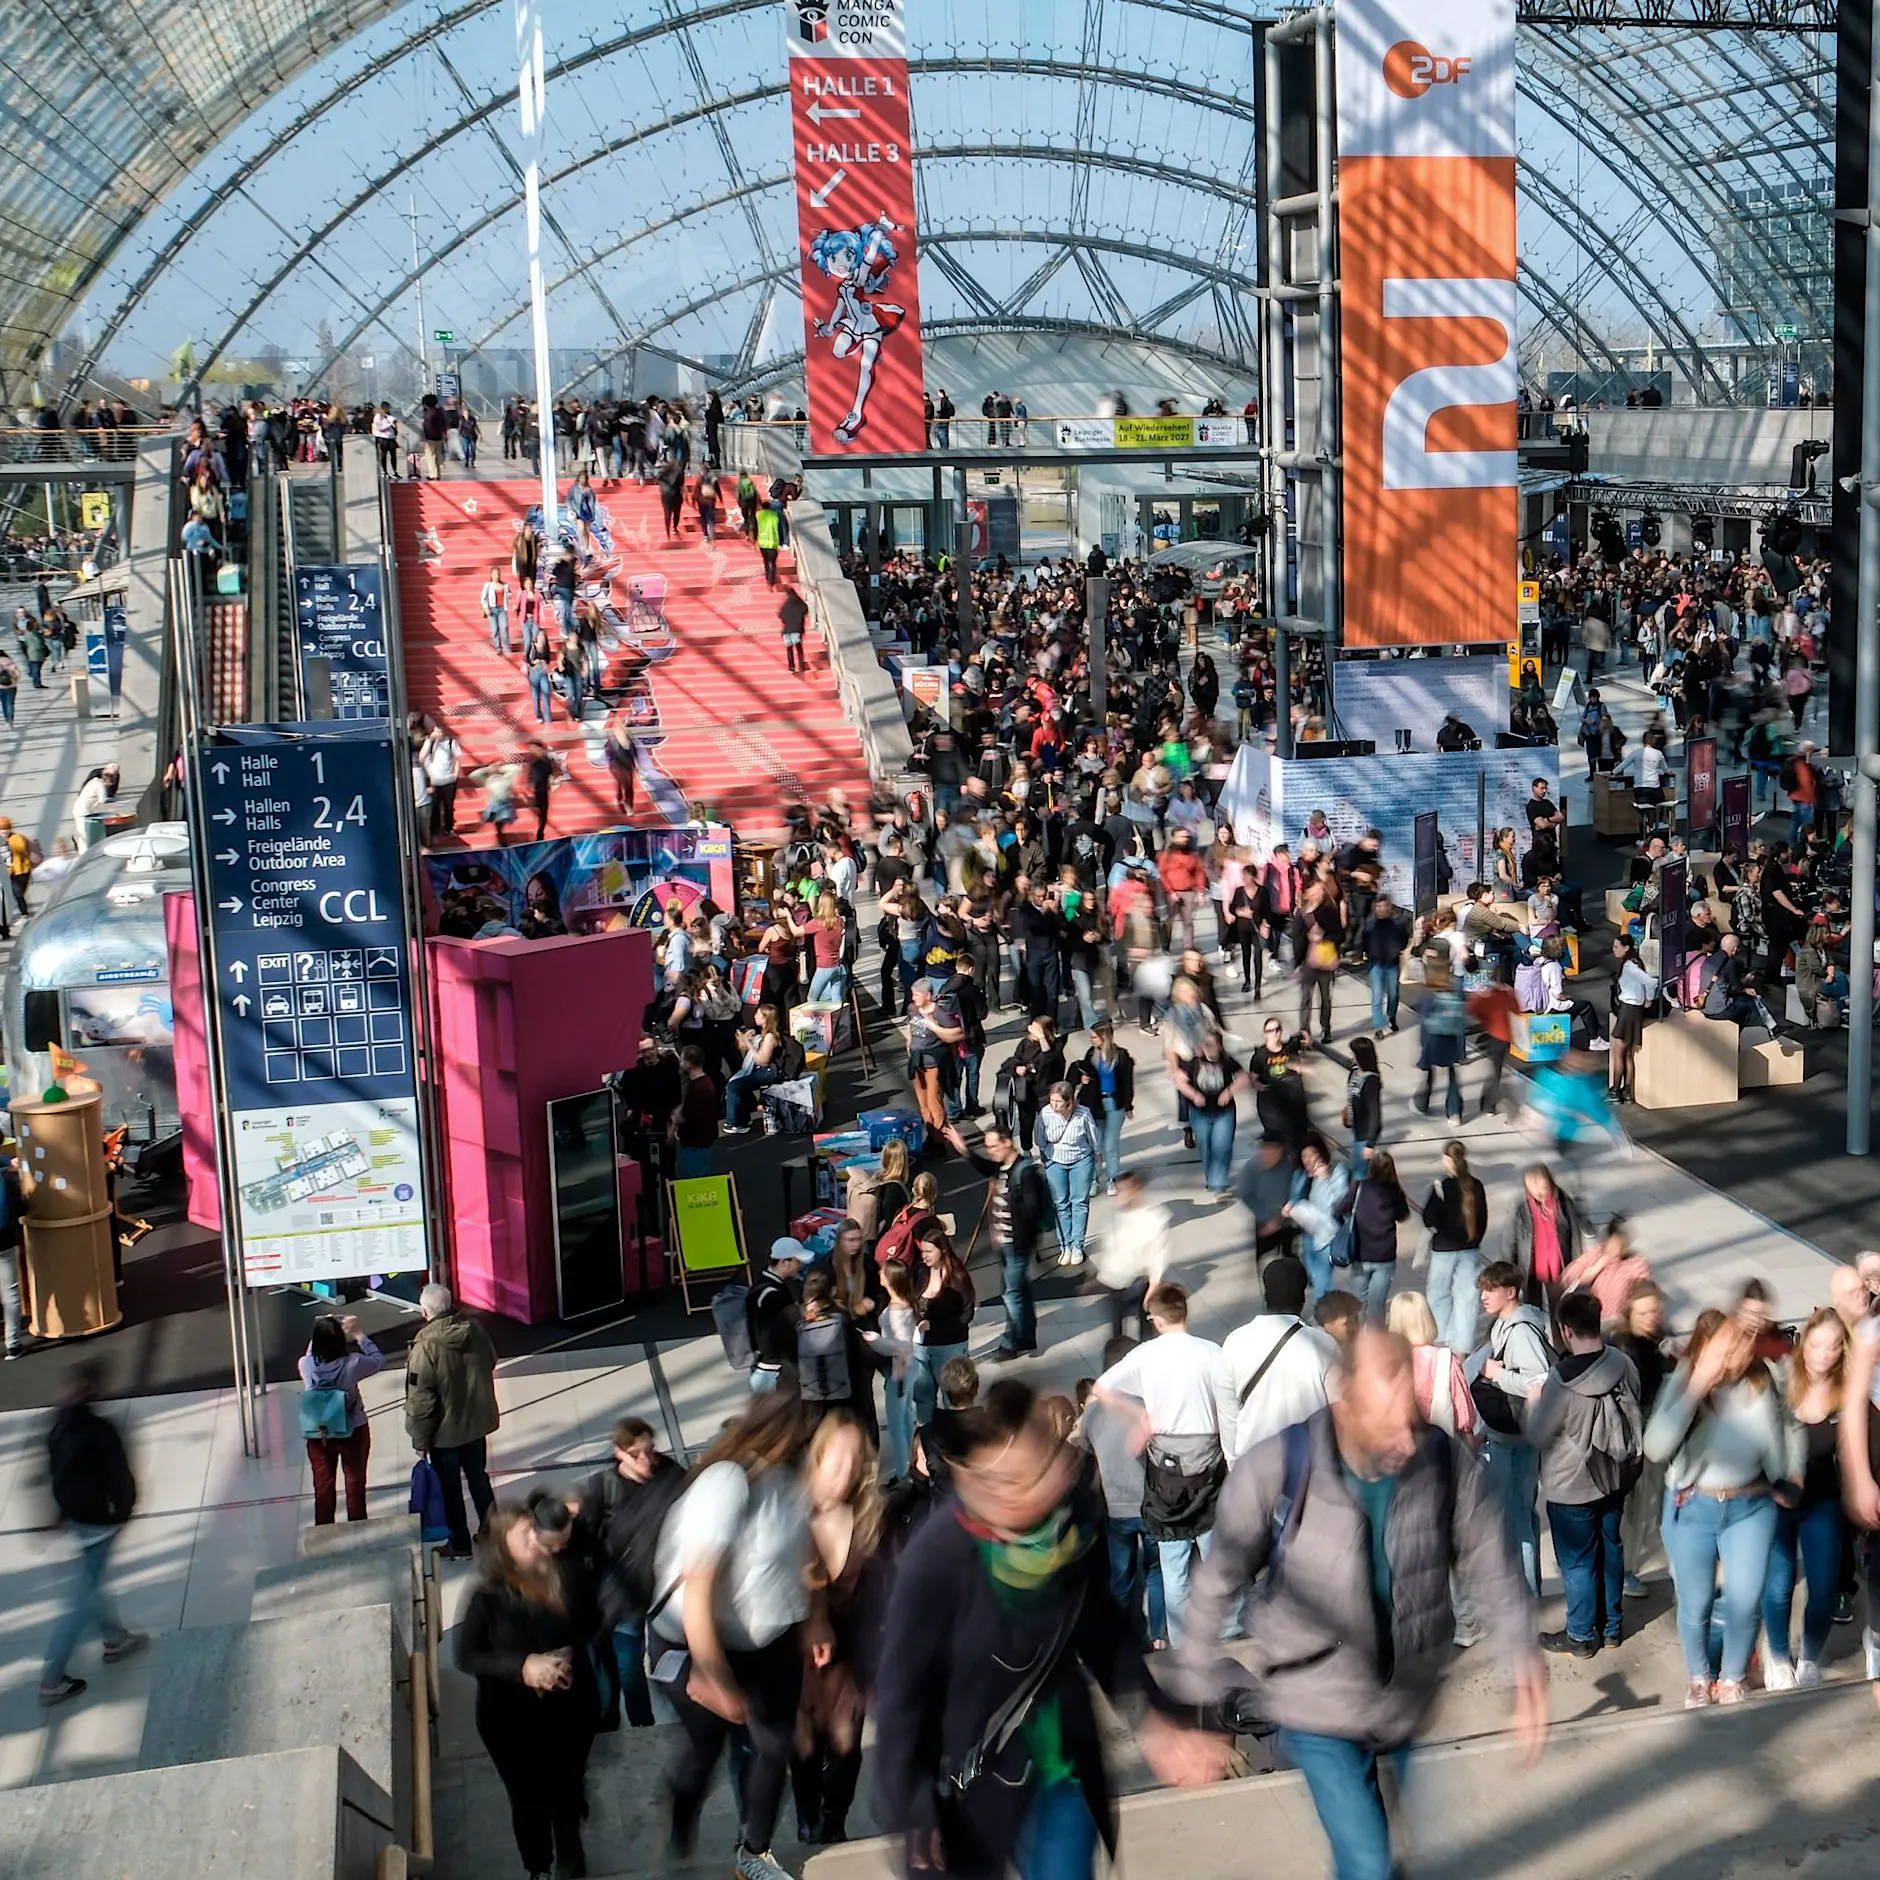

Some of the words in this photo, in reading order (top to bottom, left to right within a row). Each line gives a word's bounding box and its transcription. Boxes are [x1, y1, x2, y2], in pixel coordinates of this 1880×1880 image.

[837, 0, 895, 11] MANGA
[838, 15, 890, 28] COMIC
[839, 31, 873, 44] CON
[803, 76, 877, 96] HALLE
[882, 76, 896, 96] 1
[807, 143, 881, 163] HALLE
[886, 143, 900, 163] 3
[1119, 424, 1133, 432] Auf
[1134, 424, 1190, 432] Wiedersehen!
[1170, 433, 1190, 441] 2027
[315, 582, 330, 591] Hall
[347, 573, 356, 590] 1
[316, 594, 340, 603] Hallen
[348, 593, 377, 613] 2,4
[316, 602, 335, 611] Halls
[317, 622, 348, 631] Outdoor
[348, 622, 367, 630] Area
[319, 633, 352, 644] Congress
[319, 642, 344, 651] Center
[352, 640, 386, 658] CCL
[240, 754, 279, 771] Halle
[310, 751, 325, 784] 1
[242, 772, 271, 788] Hall
[244, 798, 291, 814] Hallen
[312, 794, 368, 833] 2,4
[245, 816, 282, 831] Halls
[247, 835, 332, 857] Freigelände
[249, 854, 309, 871] Outdoor
[312, 854, 346, 867] Area
[250, 878, 317, 895] Congress
[251, 896, 300, 911] Center
[319, 889, 388, 924] CCL
[253, 911, 304, 928] Leipzig
[260, 957, 289, 969] EXIT
